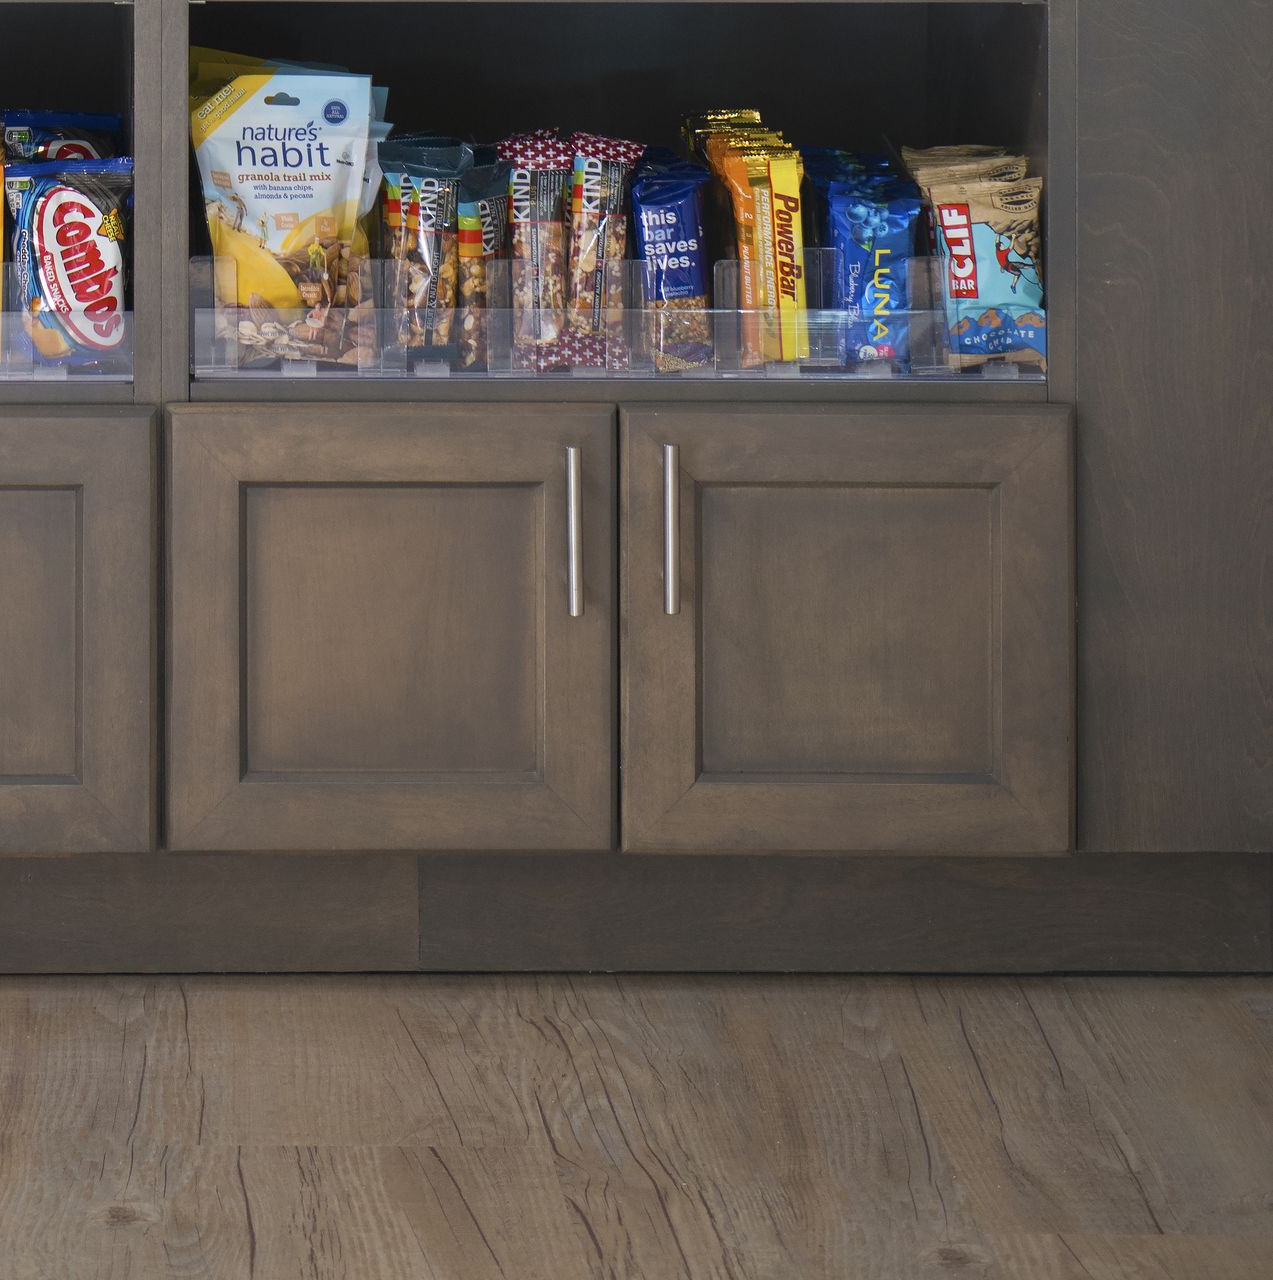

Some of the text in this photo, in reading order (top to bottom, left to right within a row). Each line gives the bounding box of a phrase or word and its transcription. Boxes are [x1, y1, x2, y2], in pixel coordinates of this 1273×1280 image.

[242, 121, 319, 142] nature's
[235, 141, 332, 168] habit
[237, 171, 332, 184] granola trail mix
[293, 184, 314, 193] chips,
[582, 157, 603, 213] KIND
[513, 169, 531, 223] KIND
[640, 209, 677, 227] this
[760, 189, 775, 269] PERFORMANCE
[643, 226, 674, 242] bar
[644, 238, 699, 256] saves
[774, 192, 803, 302] PowerBar
[940, 207, 976, 279] CLIF
[52, 200, 123, 338] Combos
[645, 254, 697, 273] lives.
[741, 245, 753, 306] PEANUT BUTTER
[873, 248, 892, 342] LUNA
[951, 279, 976, 292] BAR
